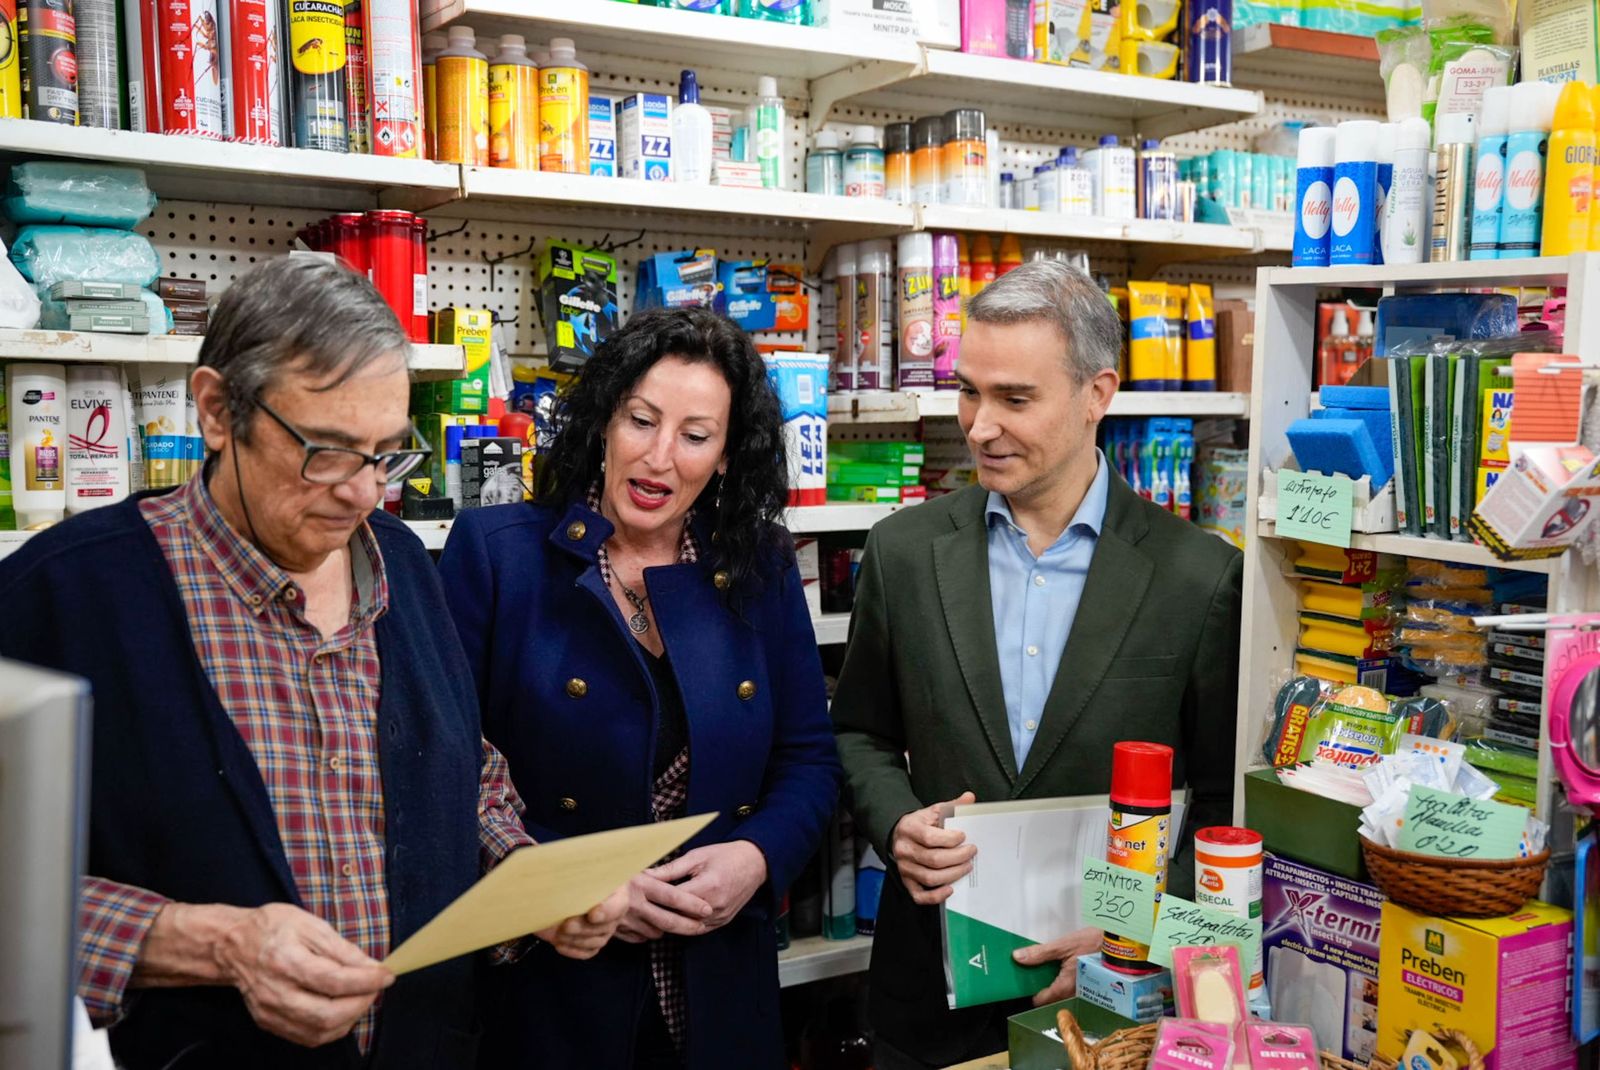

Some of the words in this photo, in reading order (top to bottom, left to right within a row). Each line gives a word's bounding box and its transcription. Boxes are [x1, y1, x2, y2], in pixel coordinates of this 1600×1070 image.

[1538, 60, 1580, 77] PLANTILLAS
[644, 136, 669, 156] ZZ
[1508, 169, 1541, 200] Nelly
[1304, 200, 1330, 225] Nelly
[1303, 247, 1326, 255] LACA
[457, 326, 487, 336] Preben
[71, 399, 113, 409] ELVIVE
[800, 424, 814, 475] LEA
[1280, 705, 1308, 754] GRATIS
[1265, 867, 1325, 892] ATTRAPE-INSECTES
[1273, 862, 1330, 885] ATRAPAINSECTOS
[1281, 938, 1303, 951] electric
[1401, 948, 1465, 986] Preben
[1406, 972, 1459, 1000] ELÉCTRICOS
[1167, 1049, 1214, 1069] BETER
[1260, 1050, 1306, 1060] BETER
